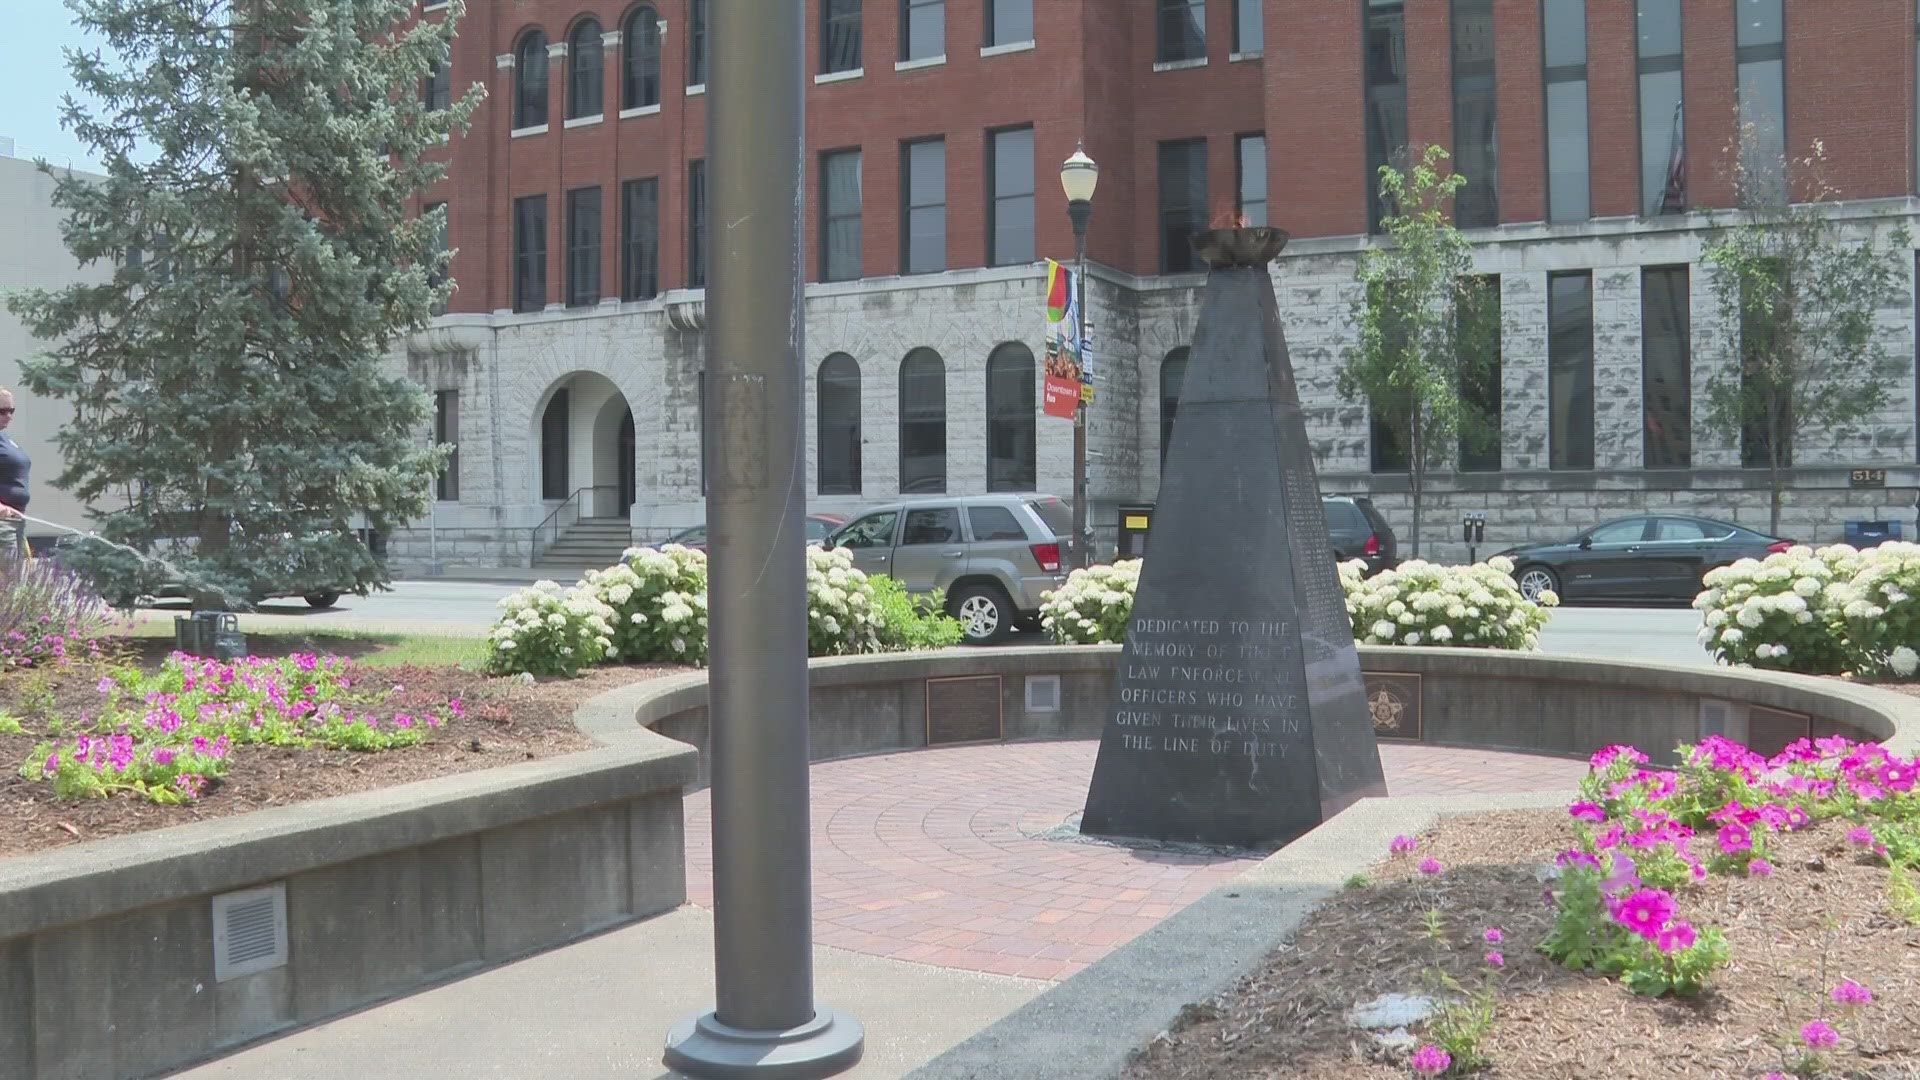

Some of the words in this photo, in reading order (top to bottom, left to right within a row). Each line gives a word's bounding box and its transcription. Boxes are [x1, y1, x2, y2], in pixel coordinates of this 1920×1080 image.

[1852, 470, 1882, 481] 514
[1136, 619, 1219, 634] DEDICATED
[1229, 621, 1249, 635] TO
[1260, 622, 1289, 636] THE
[1132, 642, 1196, 657] MEMORY
[1128, 665, 1160, 679] LAW
[1171, 667, 1290, 683] ENFORCEMNT
[1121, 688, 1196, 704] OFFICERS
[1207, 692, 1243, 707] WHO
[1255, 694, 1297, 709] HAVE
[1116, 711, 1160, 726] GIVEN
[1227, 716, 1270, 733] LIVES
[1282, 719, 1299, 733] IN
[1122, 734, 1153, 751] THE
[1164, 736, 1199, 752] LINE
[1210, 740, 1232, 754] OF
[1243, 741, 1289, 758] DUTY
